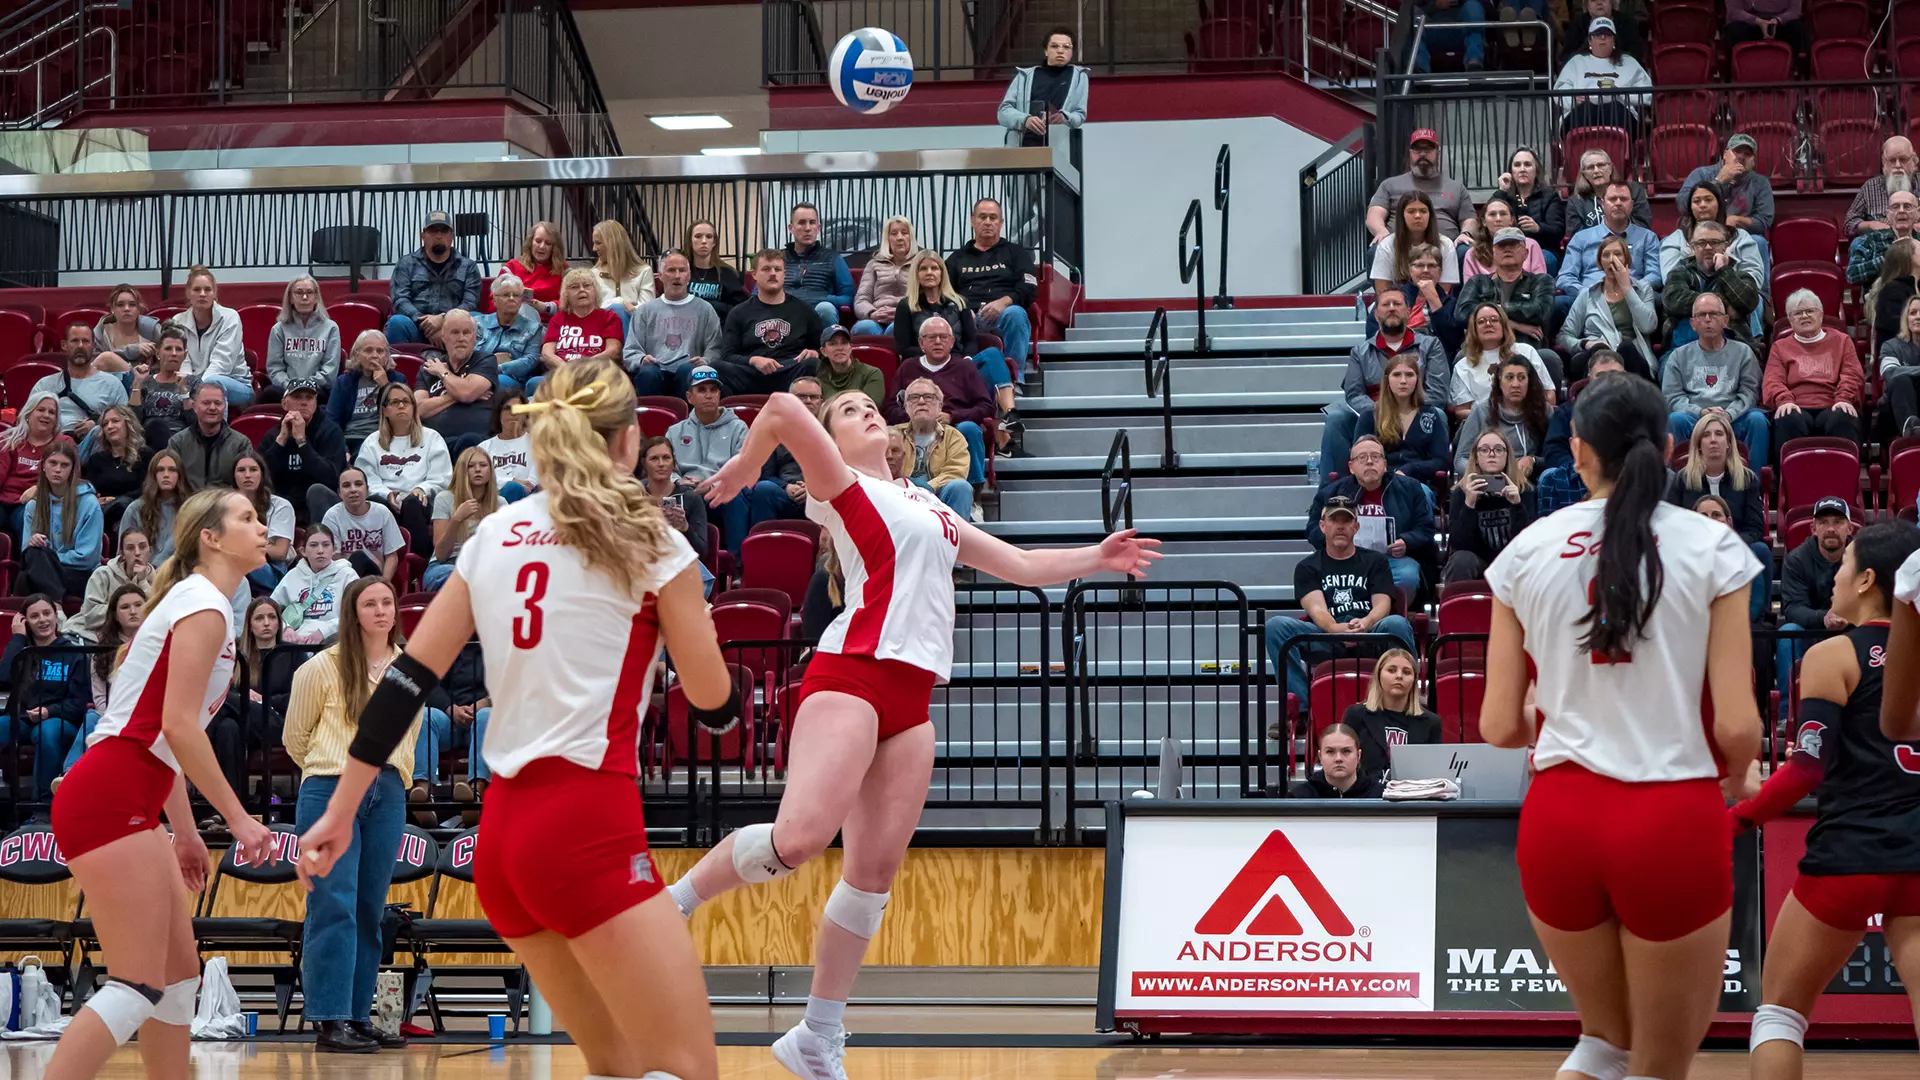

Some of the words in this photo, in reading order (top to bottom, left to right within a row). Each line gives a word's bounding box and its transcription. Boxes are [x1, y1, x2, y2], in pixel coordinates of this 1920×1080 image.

[866, 87, 907, 100] molten
[560, 325, 583, 338] GO
[755, 319, 791, 337] CWU
[285, 338, 327, 353] ENTRAL
[556, 335, 603, 349] WILD
[492, 452, 527, 468] CENTRAL
[347, 529, 362, 539] GO
[930, 509, 959, 547] 15
[1322, 574, 1368, 591] CENTRAL
[512, 561, 550, 650] 3
[1329, 600, 1371, 616] ILDCATS
[1448, 751, 1469, 778] hp
[1176, 940, 1373, 963] ANDERSON
[1446, 978, 1500, 993] THE
